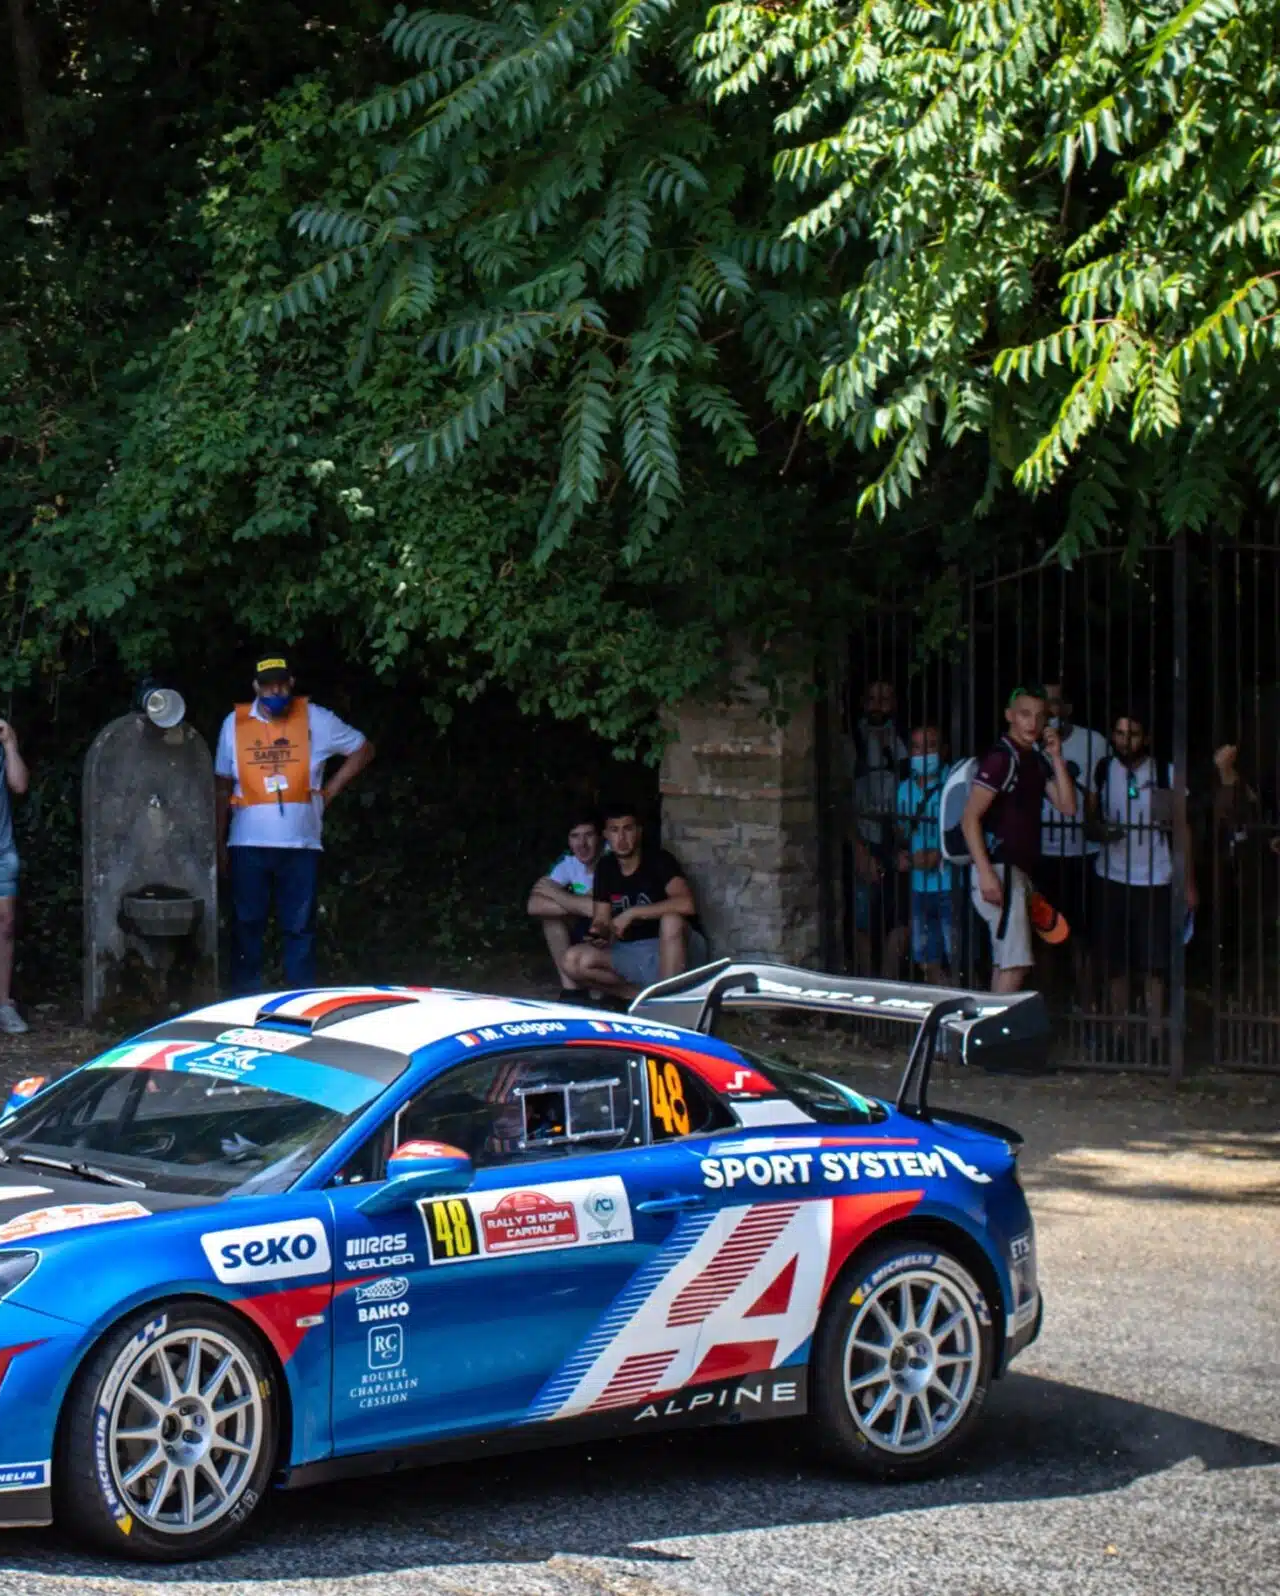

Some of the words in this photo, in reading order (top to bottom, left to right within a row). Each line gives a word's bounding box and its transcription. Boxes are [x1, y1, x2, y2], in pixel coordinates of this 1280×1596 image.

[478, 1028, 504, 1041] M.
[506, 1021, 567, 1036] Guigou
[648, 1060, 690, 1136] 48
[700, 1152, 813, 1189] SPORT
[820, 1149, 947, 1182] SYSTEM
[432, 1199, 472, 1257] 48
[487, 1215, 524, 1229] RALLY
[525, 1213, 537, 1224] DI
[538, 1209, 571, 1222] ROMA
[506, 1223, 557, 1239] CAPITALE
[587, 1228, 625, 1241] SPORT
[1010, 1235, 1030, 1259] ETS
[872, 1254, 934, 1286] MICHELIN
[349, 1378, 419, 1399] CHAPALAIN
[359, 1392, 408, 1409] CESSION
[633, 1382, 797, 1421] ALPINE
[96, 1414, 118, 1505] MICHELIN
